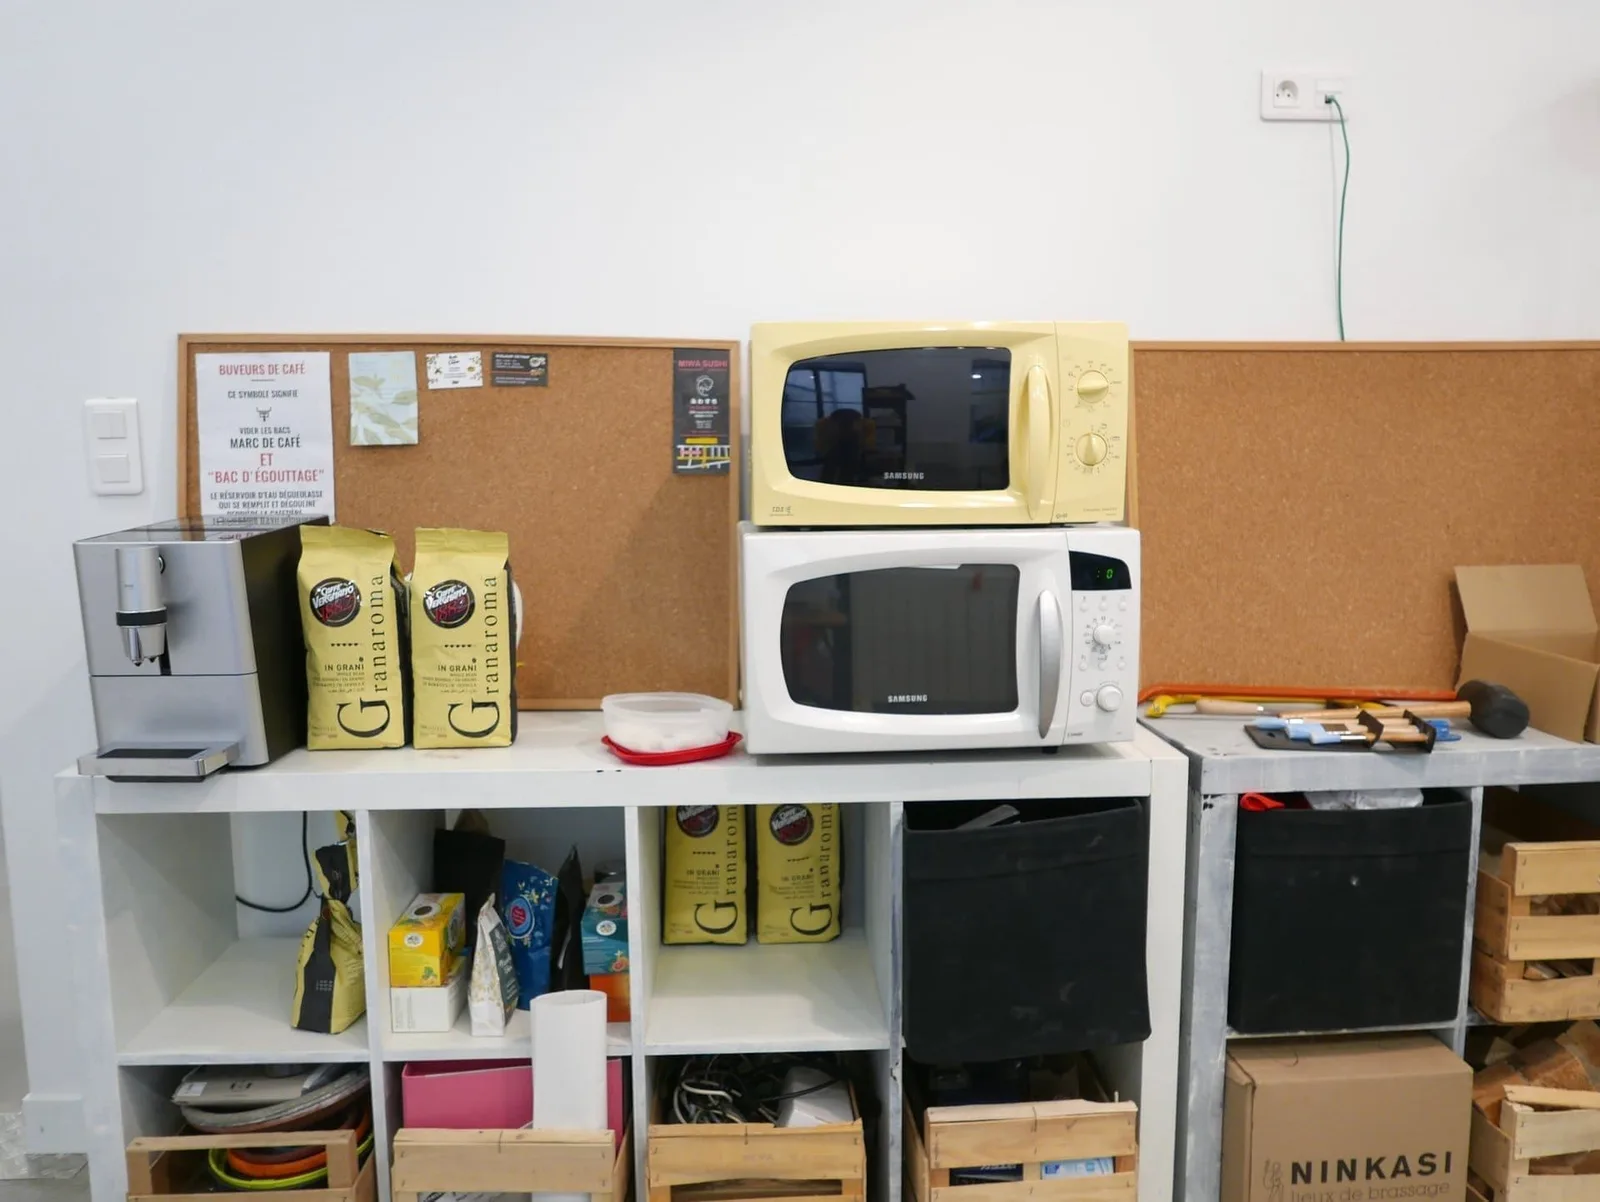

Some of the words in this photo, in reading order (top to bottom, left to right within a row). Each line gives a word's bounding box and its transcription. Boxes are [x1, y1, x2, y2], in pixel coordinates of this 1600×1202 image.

[219, 364, 265, 376] BUVEURS
[268, 364, 279, 374] DE
[282, 362, 306, 374] CAFÉ
[678, 359, 700, 368] MIWA
[702, 359, 728, 368] SUSHI
[228, 390, 236, 398] CE
[239, 390, 269, 398] SYMBOLE
[271, 390, 298, 398] SIGNIFIE
[274, 426, 291, 434] BACS
[230, 438, 259, 448] MARC
[262, 437, 274, 448] DE
[278, 434, 301, 448] CAFÉ
[260, 454, 273, 466] ET
[884, 472, 924, 480] SAMSUNG
[210, 492, 218, 500] LE
[220, 490, 256, 500] RÉSERVOIR
[218, 501, 230, 509] QUI
[242, 500, 270, 508] REMPLIT
[272, 500, 279, 508] ET
[336, 575, 390, 738] Granaroma
[447, 577, 500, 738] Granaroma
[449, 664, 477, 672] GRANI
[888, 694, 928, 703] SAMSUNG
[694, 806, 738, 934] Granarom
[1290, 1151, 1452, 1185] NINKASI
[1340, 1187, 1362, 1200] de
[1368, 1182, 1450, 1200] brassage
